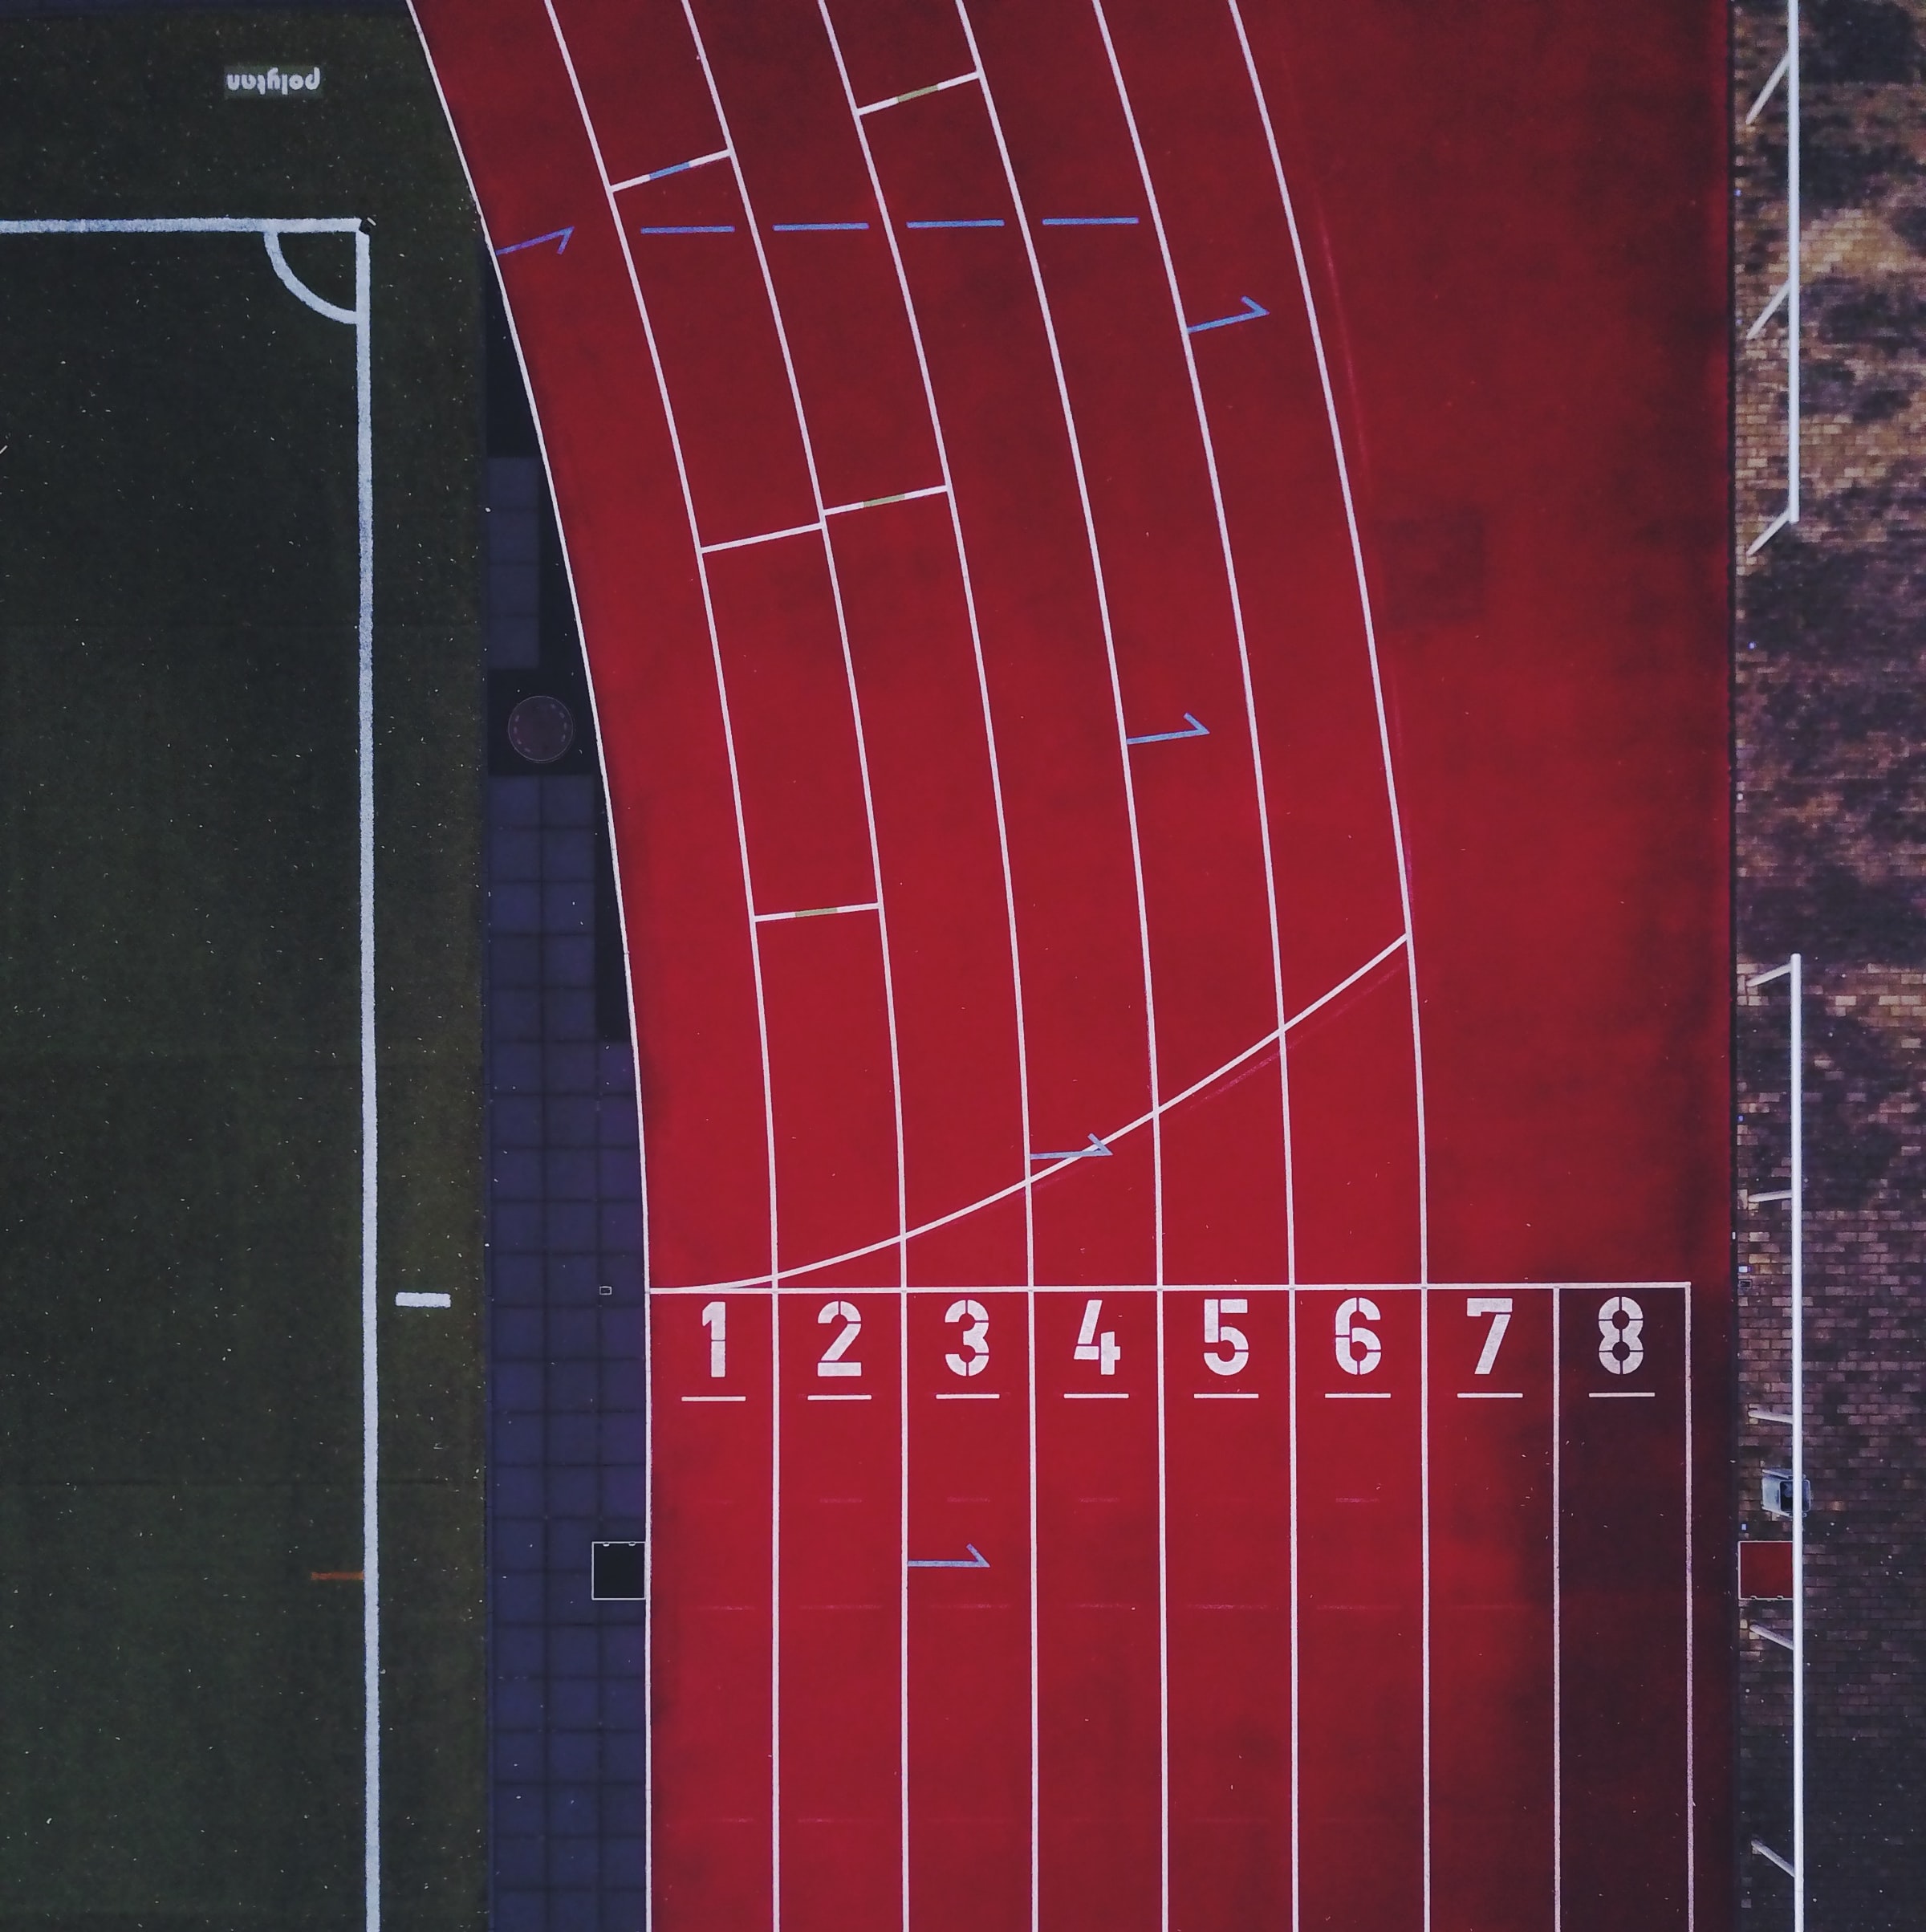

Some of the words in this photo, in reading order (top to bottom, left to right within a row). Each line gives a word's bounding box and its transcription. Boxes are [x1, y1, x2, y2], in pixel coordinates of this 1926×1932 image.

[226, 67, 320, 95] polytan
[701, 1301, 726, 1378] 1
[817, 1300, 862, 1377] 2
[945, 1300, 989, 1377] 3
[1073, 1300, 1121, 1376] 4
[1203, 1299, 1249, 1376] 5
[1335, 1297, 1382, 1376] 6
[1466, 1297, 1513, 1375] 7
[1598, 1296, 1644, 1375] 8
